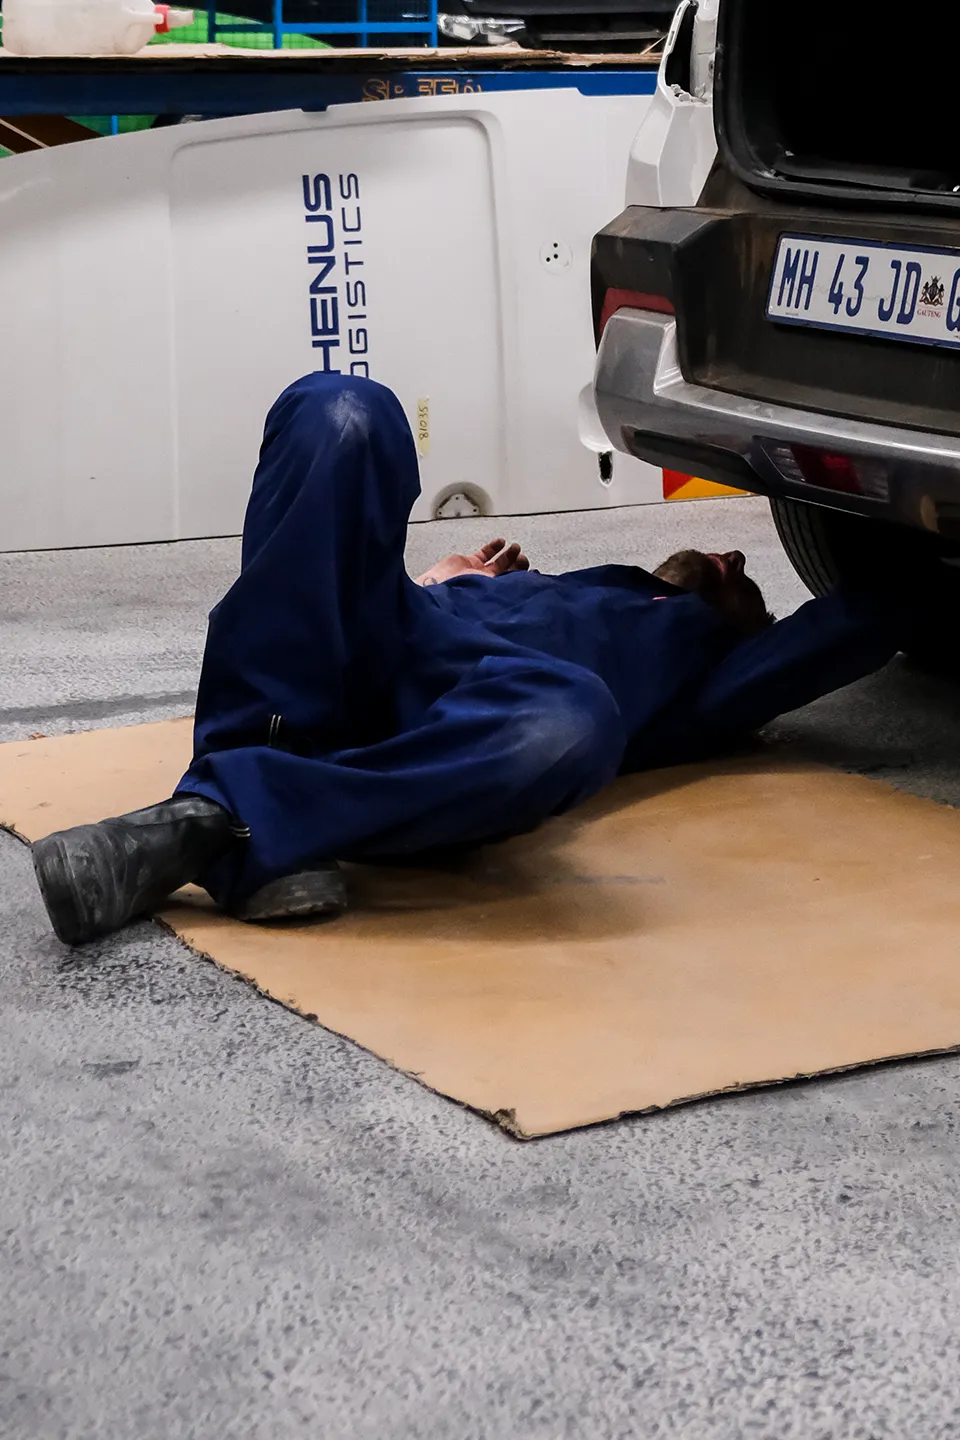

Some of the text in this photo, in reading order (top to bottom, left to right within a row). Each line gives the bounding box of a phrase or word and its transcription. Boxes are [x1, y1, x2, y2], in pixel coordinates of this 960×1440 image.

[301, 172, 342, 375] HENUS
[776, 247, 820, 311] MH
[827, 253, 870, 318] 43
[877, 259, 923, 325] JD
